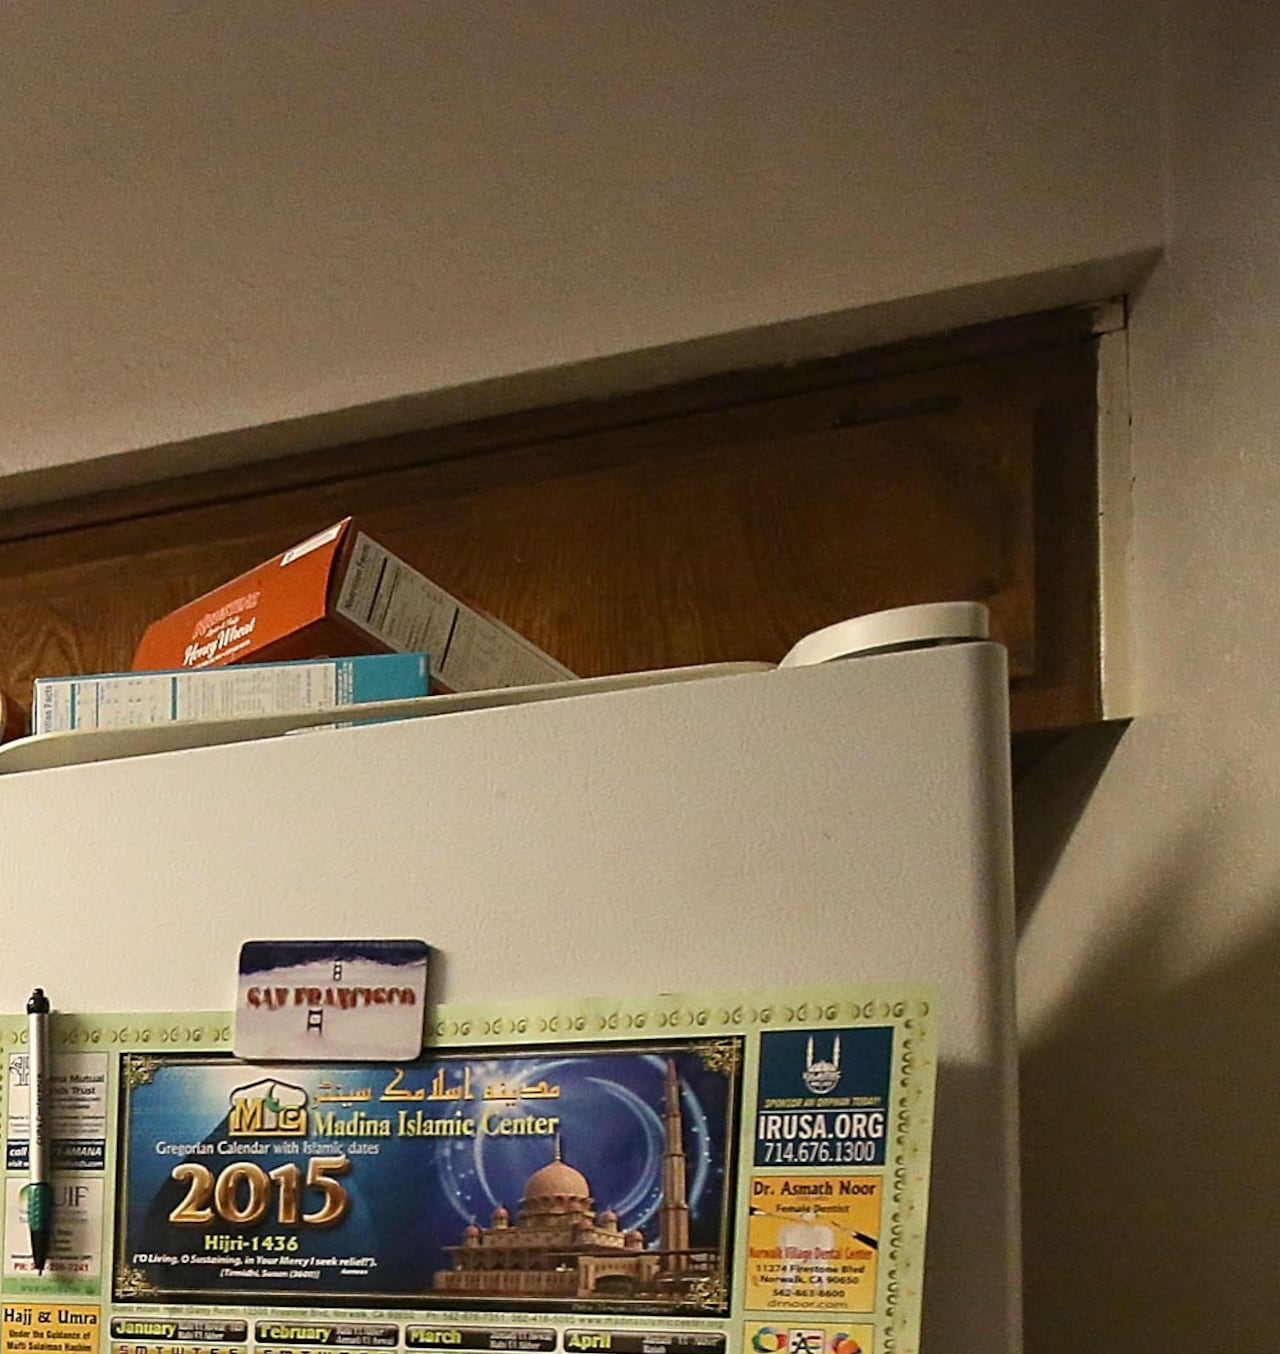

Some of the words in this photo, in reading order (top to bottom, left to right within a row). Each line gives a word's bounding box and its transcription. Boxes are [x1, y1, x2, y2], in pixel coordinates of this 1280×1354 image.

[247, 986, 289, 1011] SAN
[293, 986, 417, 1011] FRANCISCO
[69, 1073, 105, 1084] Mutual
[72, 1086, 96, 1096] Trust
[313, 1110, 391, 1137] Madina
[397, 1109, 476, 1137] Islamic
[481, 1112, 560, 1137] Center
[758, 1112, 885, 1140] IRUSA.ORG
[155, 1140, 214, 1157] Gregorian
[216, 1139, 270, 1155] Calendar
[273, 1140, 300, 1155] with
[302, 1140, 344, 1155] Islamic
[347, 1141, 380, 1155] dates
[764, 1140, 877, 1163] 714.676.1300
[168, 1153, 353, 1225] 2015
[753, 1182, 775, 1196] Dr.
[780, 1180, 833, 1197] Asmath
[839, 1180, 877, 1196] Noor
[776, 1204, 812, 1214] Female
[814, 1204, 850, 1214] Dentist
[204, 1235, 300, 1254] Hijri-1436
[809, 1275, 824, 1285] CA
[2, 1308, 33, 1326] Hajj
[58, 1309, 98, 1325] Umra
[116, 1322, 177, 1339] January
[259, 1325, 332, 1341] February
[409, 1329, 463, 1345] March
[567, 1334, 613, 1351] April
